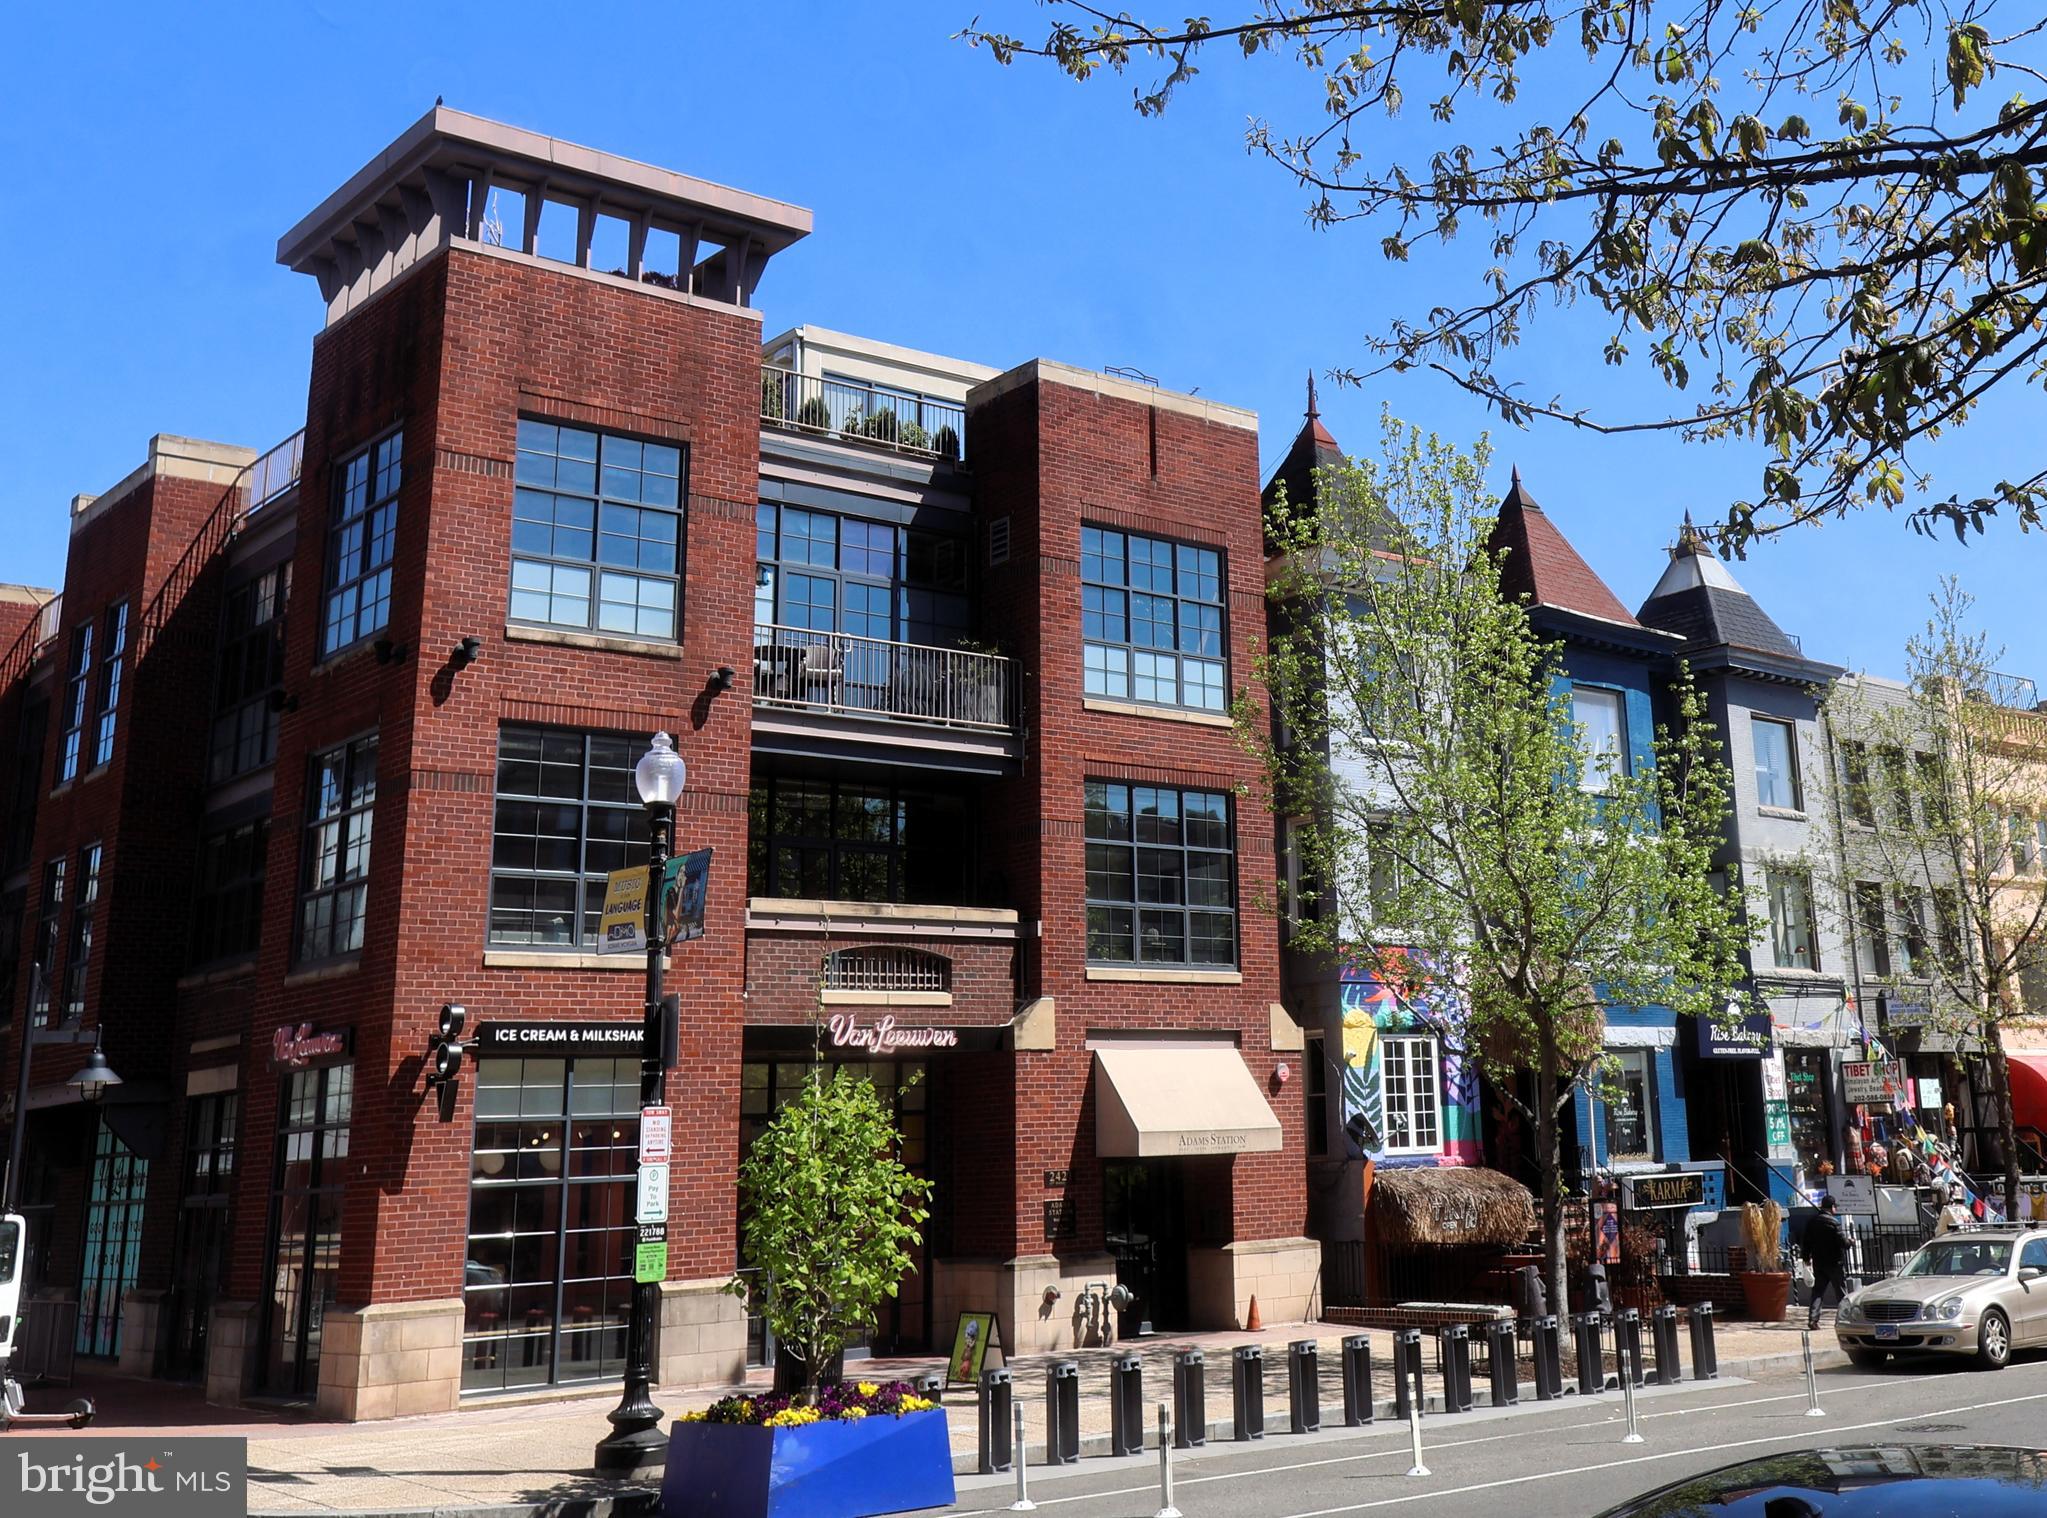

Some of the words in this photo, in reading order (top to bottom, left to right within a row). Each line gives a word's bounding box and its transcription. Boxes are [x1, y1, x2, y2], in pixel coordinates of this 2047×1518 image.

[605, 899, 641, 915] LANGUAGE
[495, 1030, 517, 1041] ICE
[520, 1030, 567, 1041] CREAM
[570, 1030, 579, 1041] &
[582, 1030, 644, 1041] MILKSHAK
[830, 1014, 874, 1046] Van
[869, 1015, 959, 1053] Leeuwen
[1710, 1024, 1730, 1041] Rise
[1844, 1064, 1870, 1077] TIBET
[1179, 1135, 1209, 1146] ADAMS
[1210, 1133, 1246, 1145] STATION
[1772, 1131, 1785, 1141] OFF
[1650, 1180, 1687, 1201] KARMA
